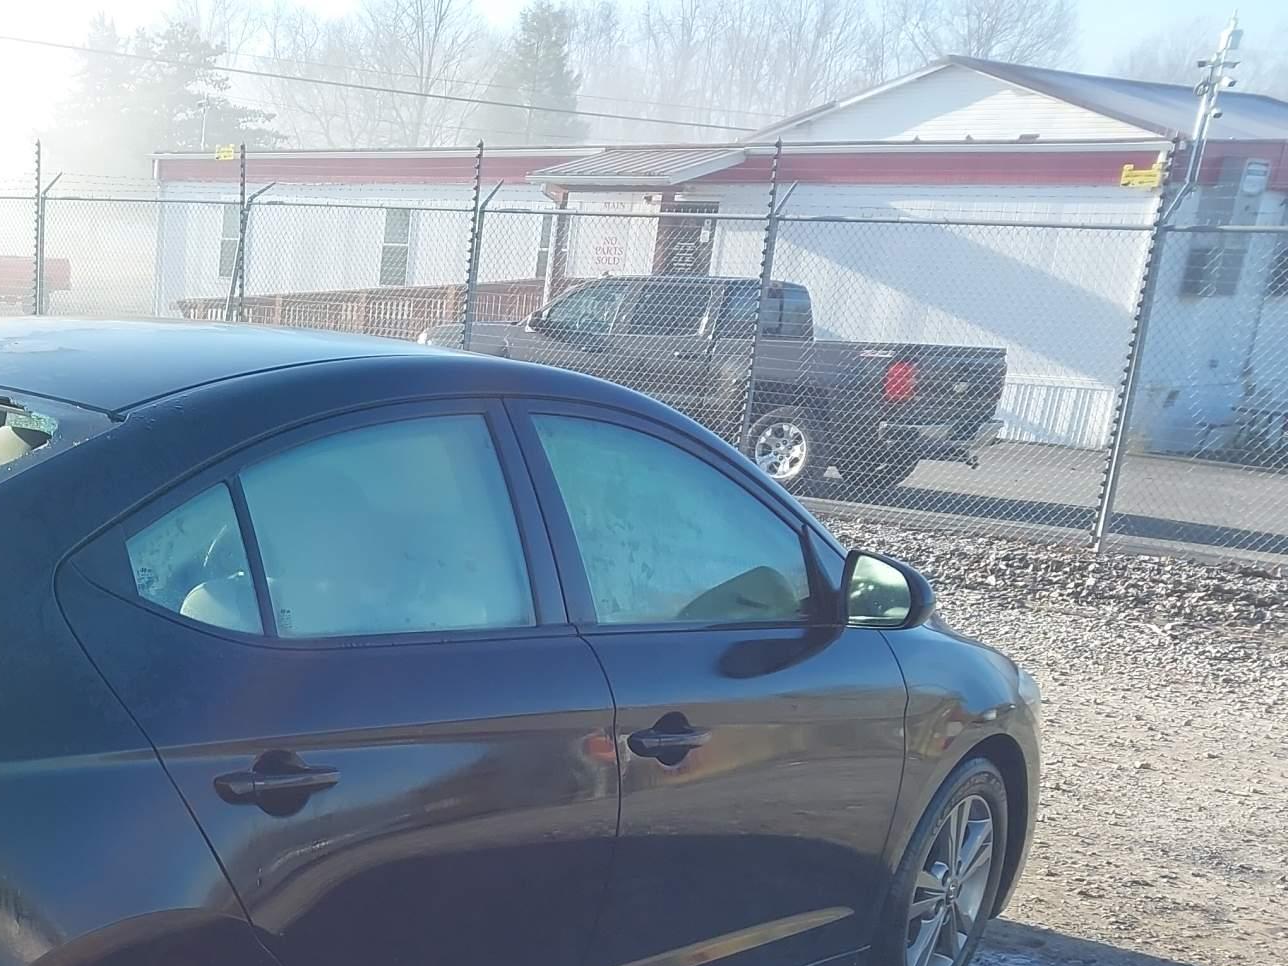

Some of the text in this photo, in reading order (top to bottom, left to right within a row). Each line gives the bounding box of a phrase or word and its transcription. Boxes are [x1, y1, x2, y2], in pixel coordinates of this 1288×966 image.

[604, 236, 618, 246] NO
[595, 246, 624, 256] PARTS
[595, 256, 620, 265] SOLD
